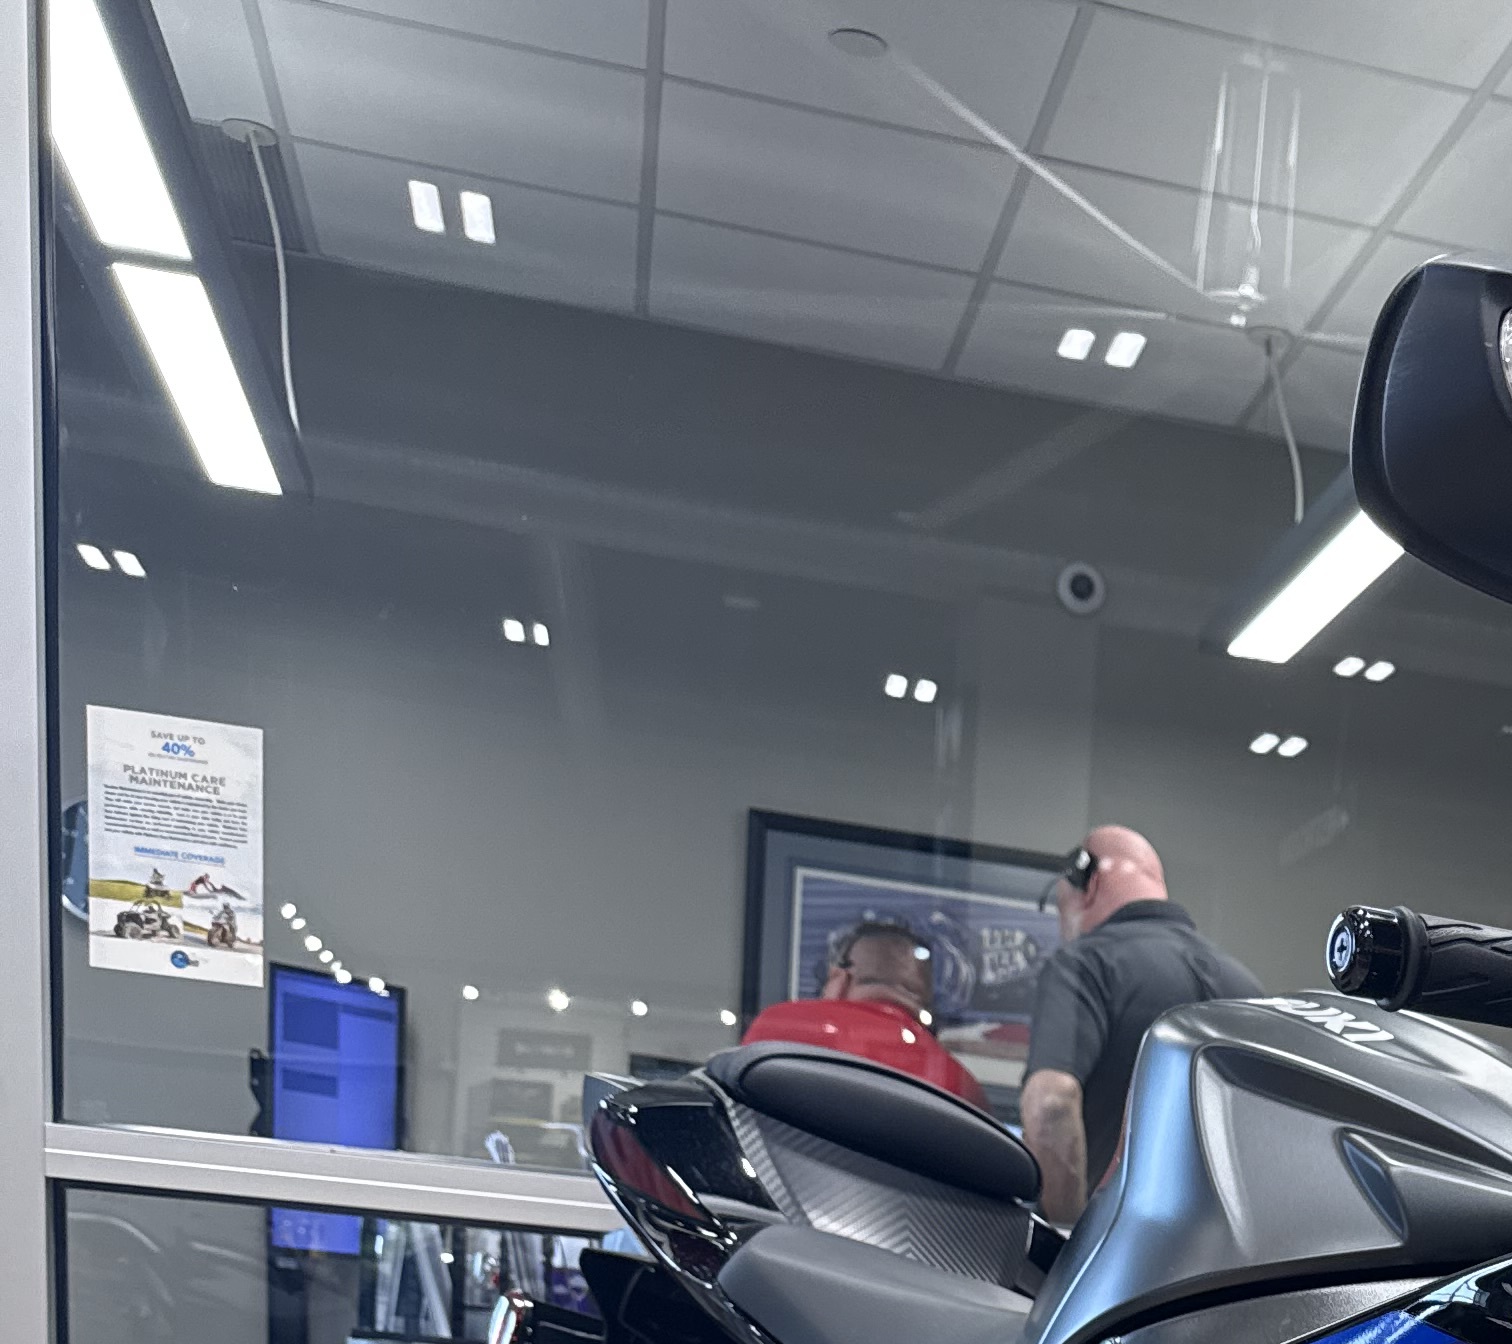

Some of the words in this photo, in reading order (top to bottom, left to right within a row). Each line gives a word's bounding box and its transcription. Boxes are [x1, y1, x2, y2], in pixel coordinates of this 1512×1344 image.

[151, 731, 174, 741] SAVE
[177, 733, 190, 743] UP
[193, 735, 206, 745] TO
[161, 742, 195, 757] 40%
[123, 764, 188, 781] PLATINUM
[191, 773, 226, 787] CARE
[128, 775, 221, 796] MAINTENANCE
